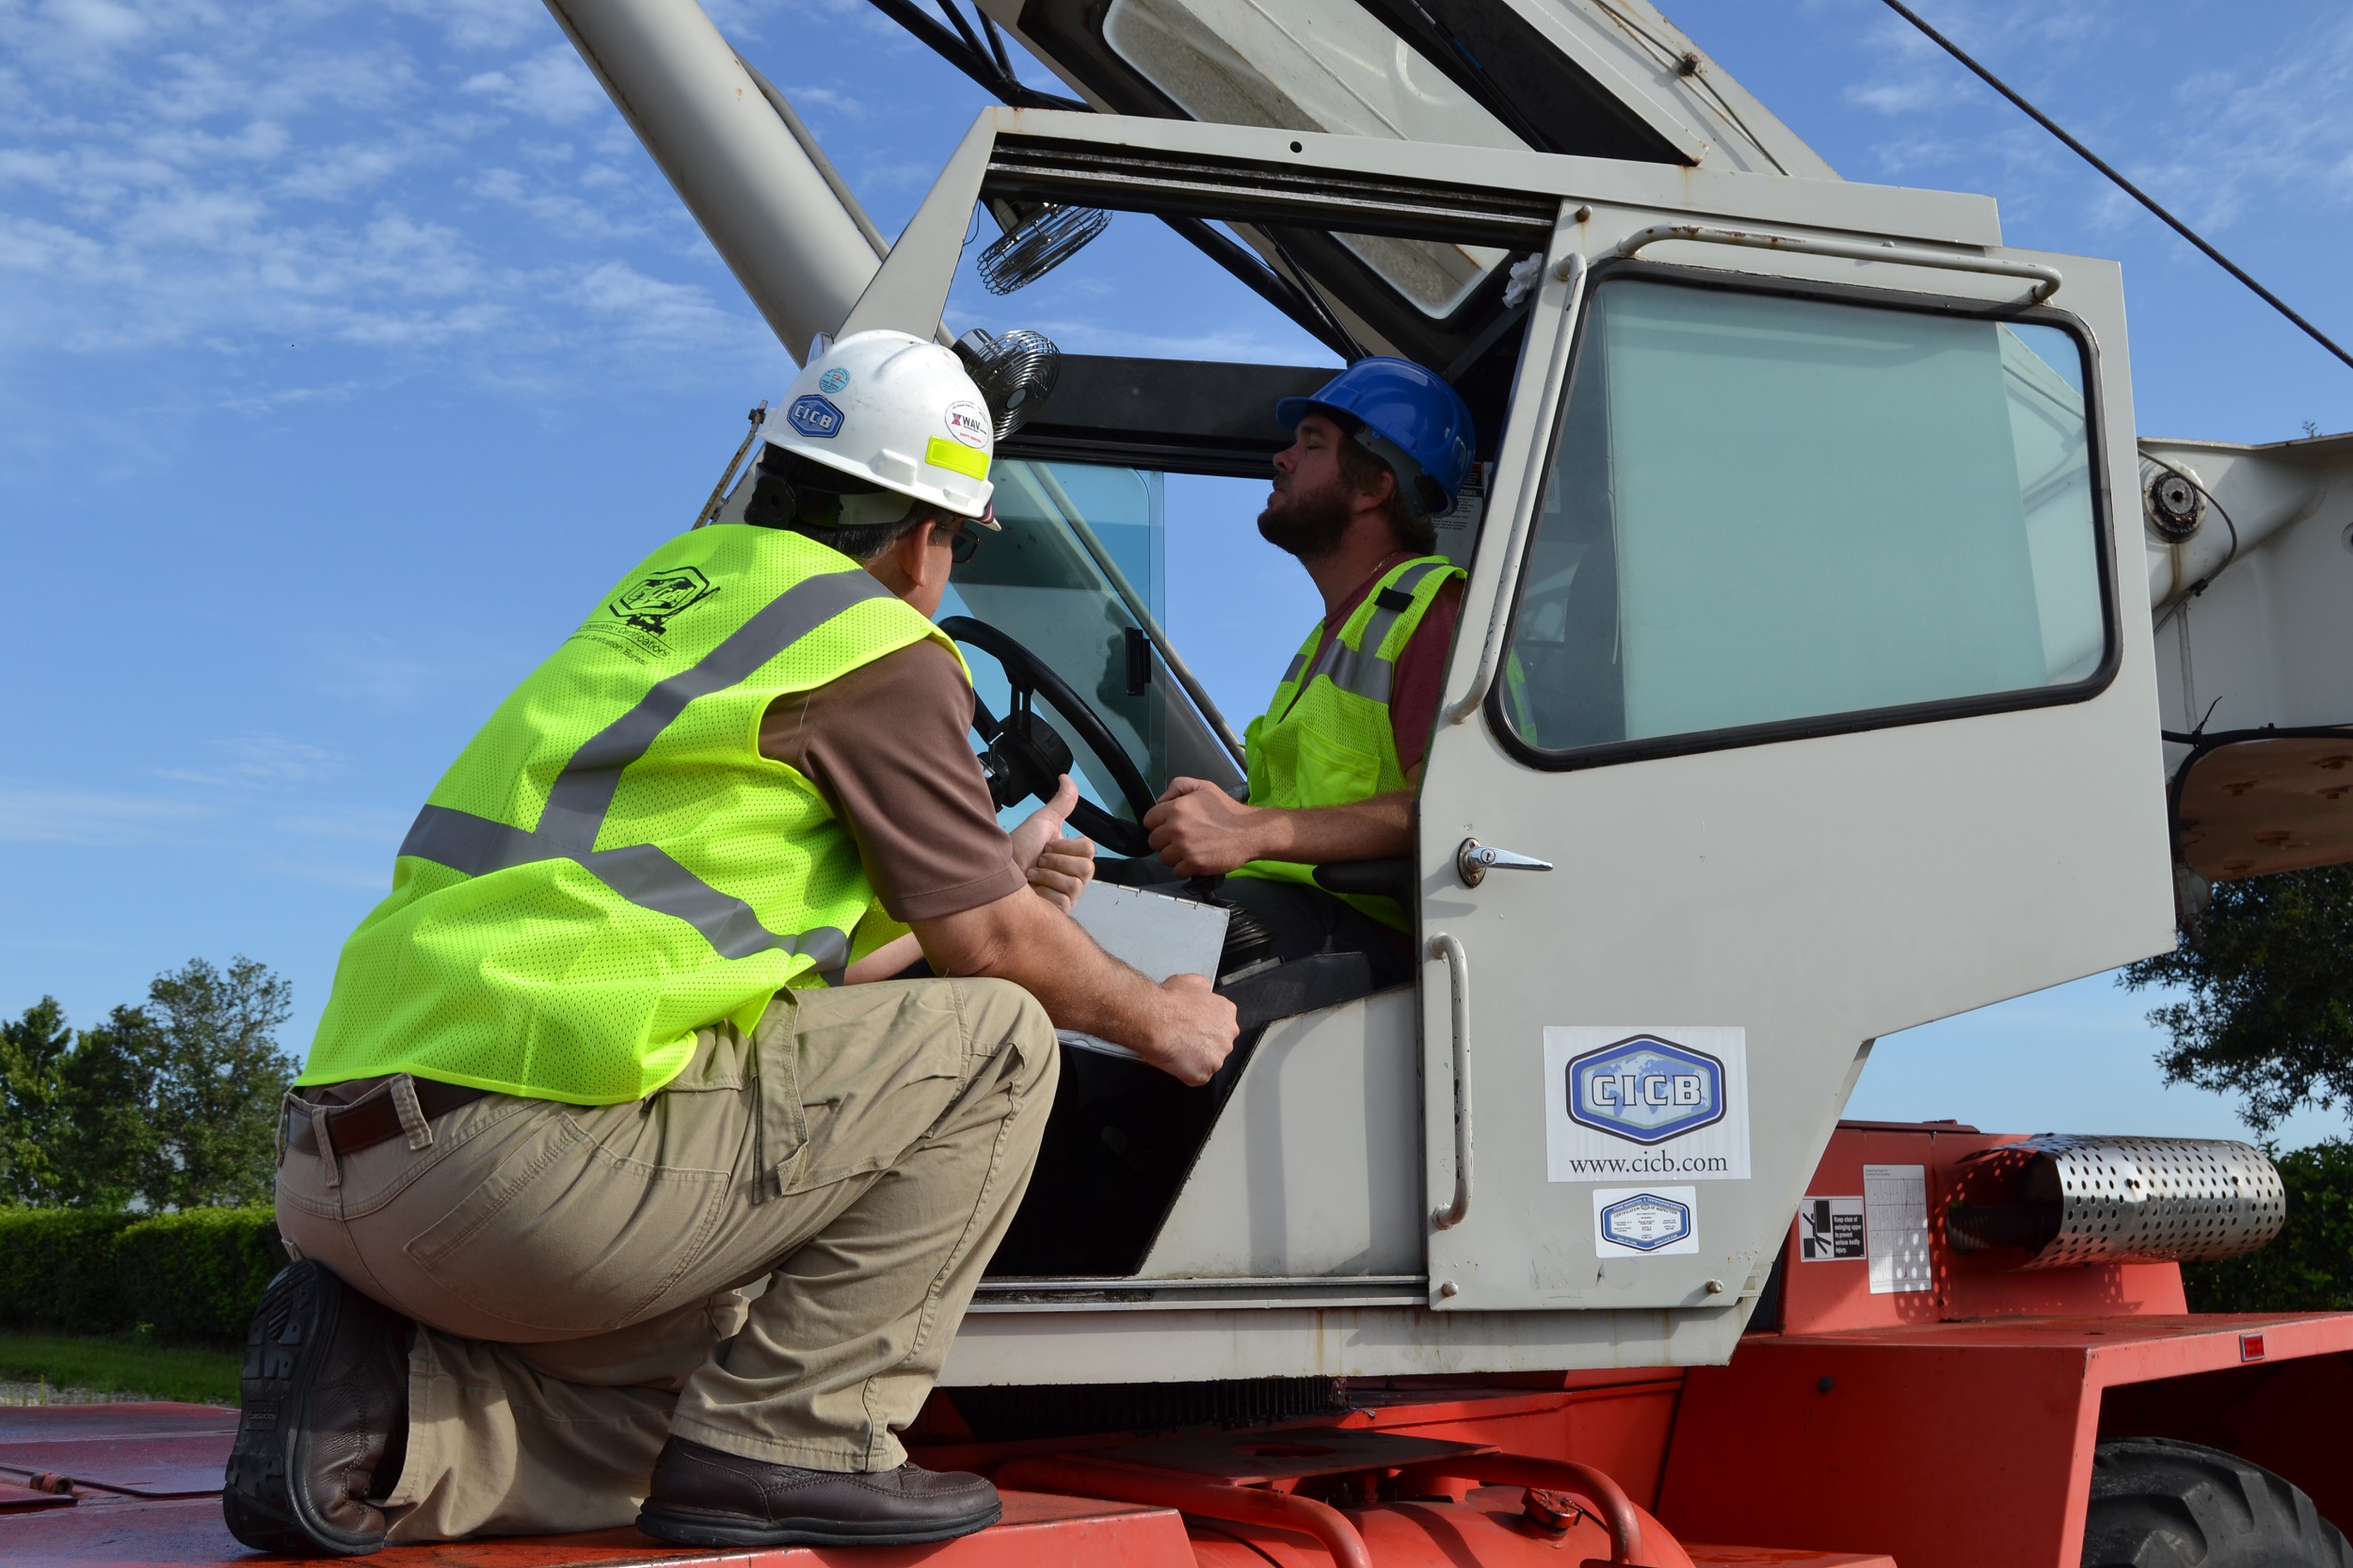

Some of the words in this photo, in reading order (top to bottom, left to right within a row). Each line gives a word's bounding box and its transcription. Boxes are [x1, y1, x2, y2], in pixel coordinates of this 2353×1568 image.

[794, 405, 833, 429] CICB
[962, 415, 981, 431] WAV
[1592, 1075, 1702, 1107] CICB
[1569, 1149, 1729, 1174] www.cicb.com
[1613, 1207, 1641, 1218] CERTIFICATION
[1656, 1207, 1678, 1215] INSPECTION
